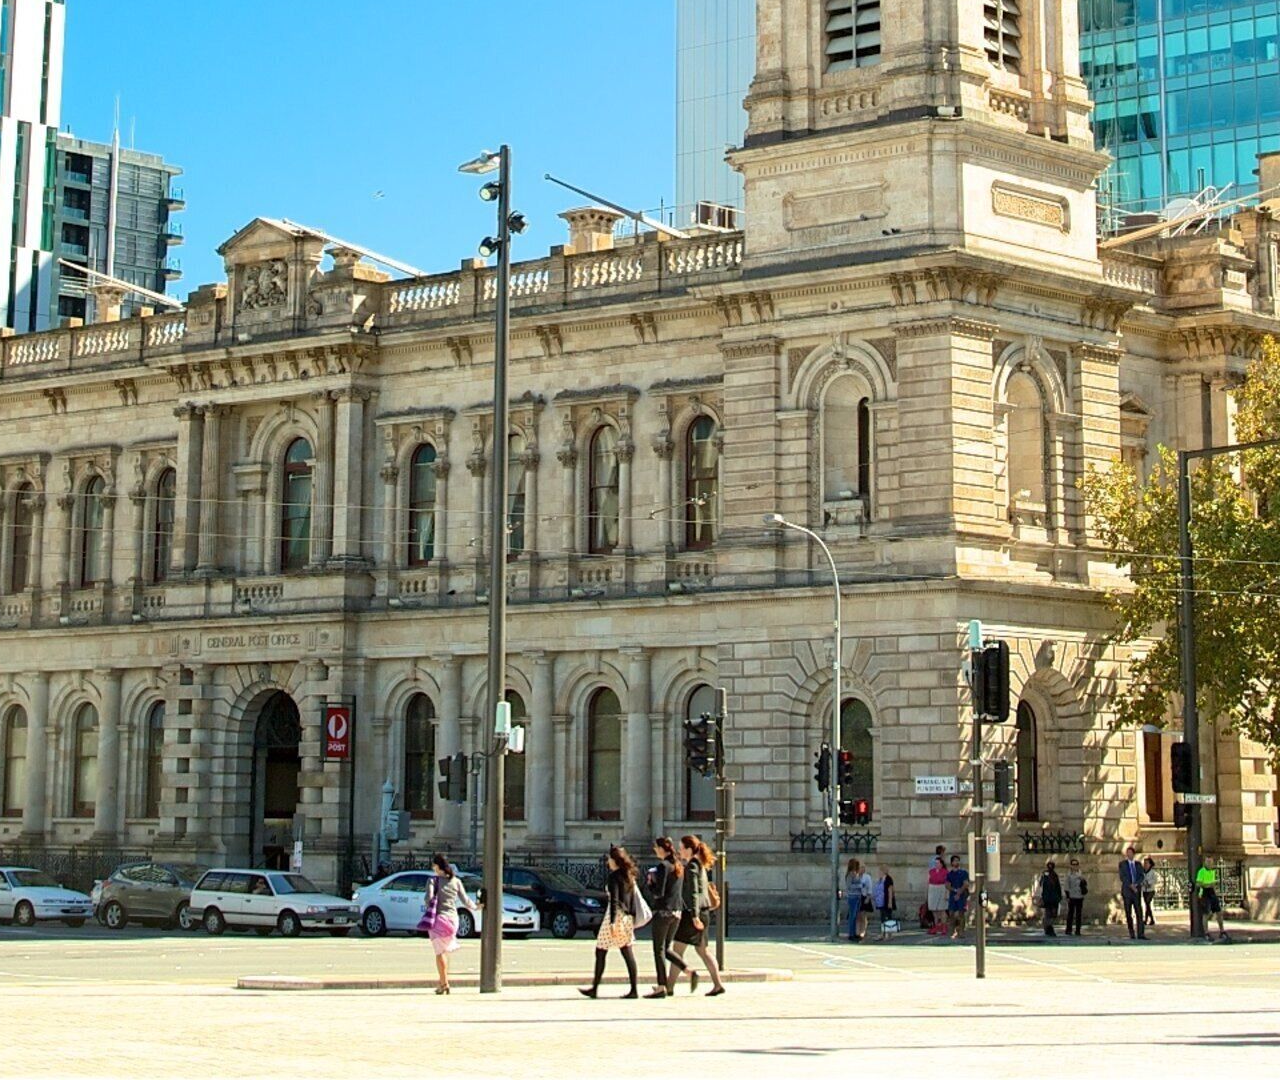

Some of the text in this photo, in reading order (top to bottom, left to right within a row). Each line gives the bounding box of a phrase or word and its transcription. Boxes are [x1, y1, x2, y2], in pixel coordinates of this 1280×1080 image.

[207, 633, 300, 649] GENERAL POST OFFICE
[327, 743, 346, 752] POST
